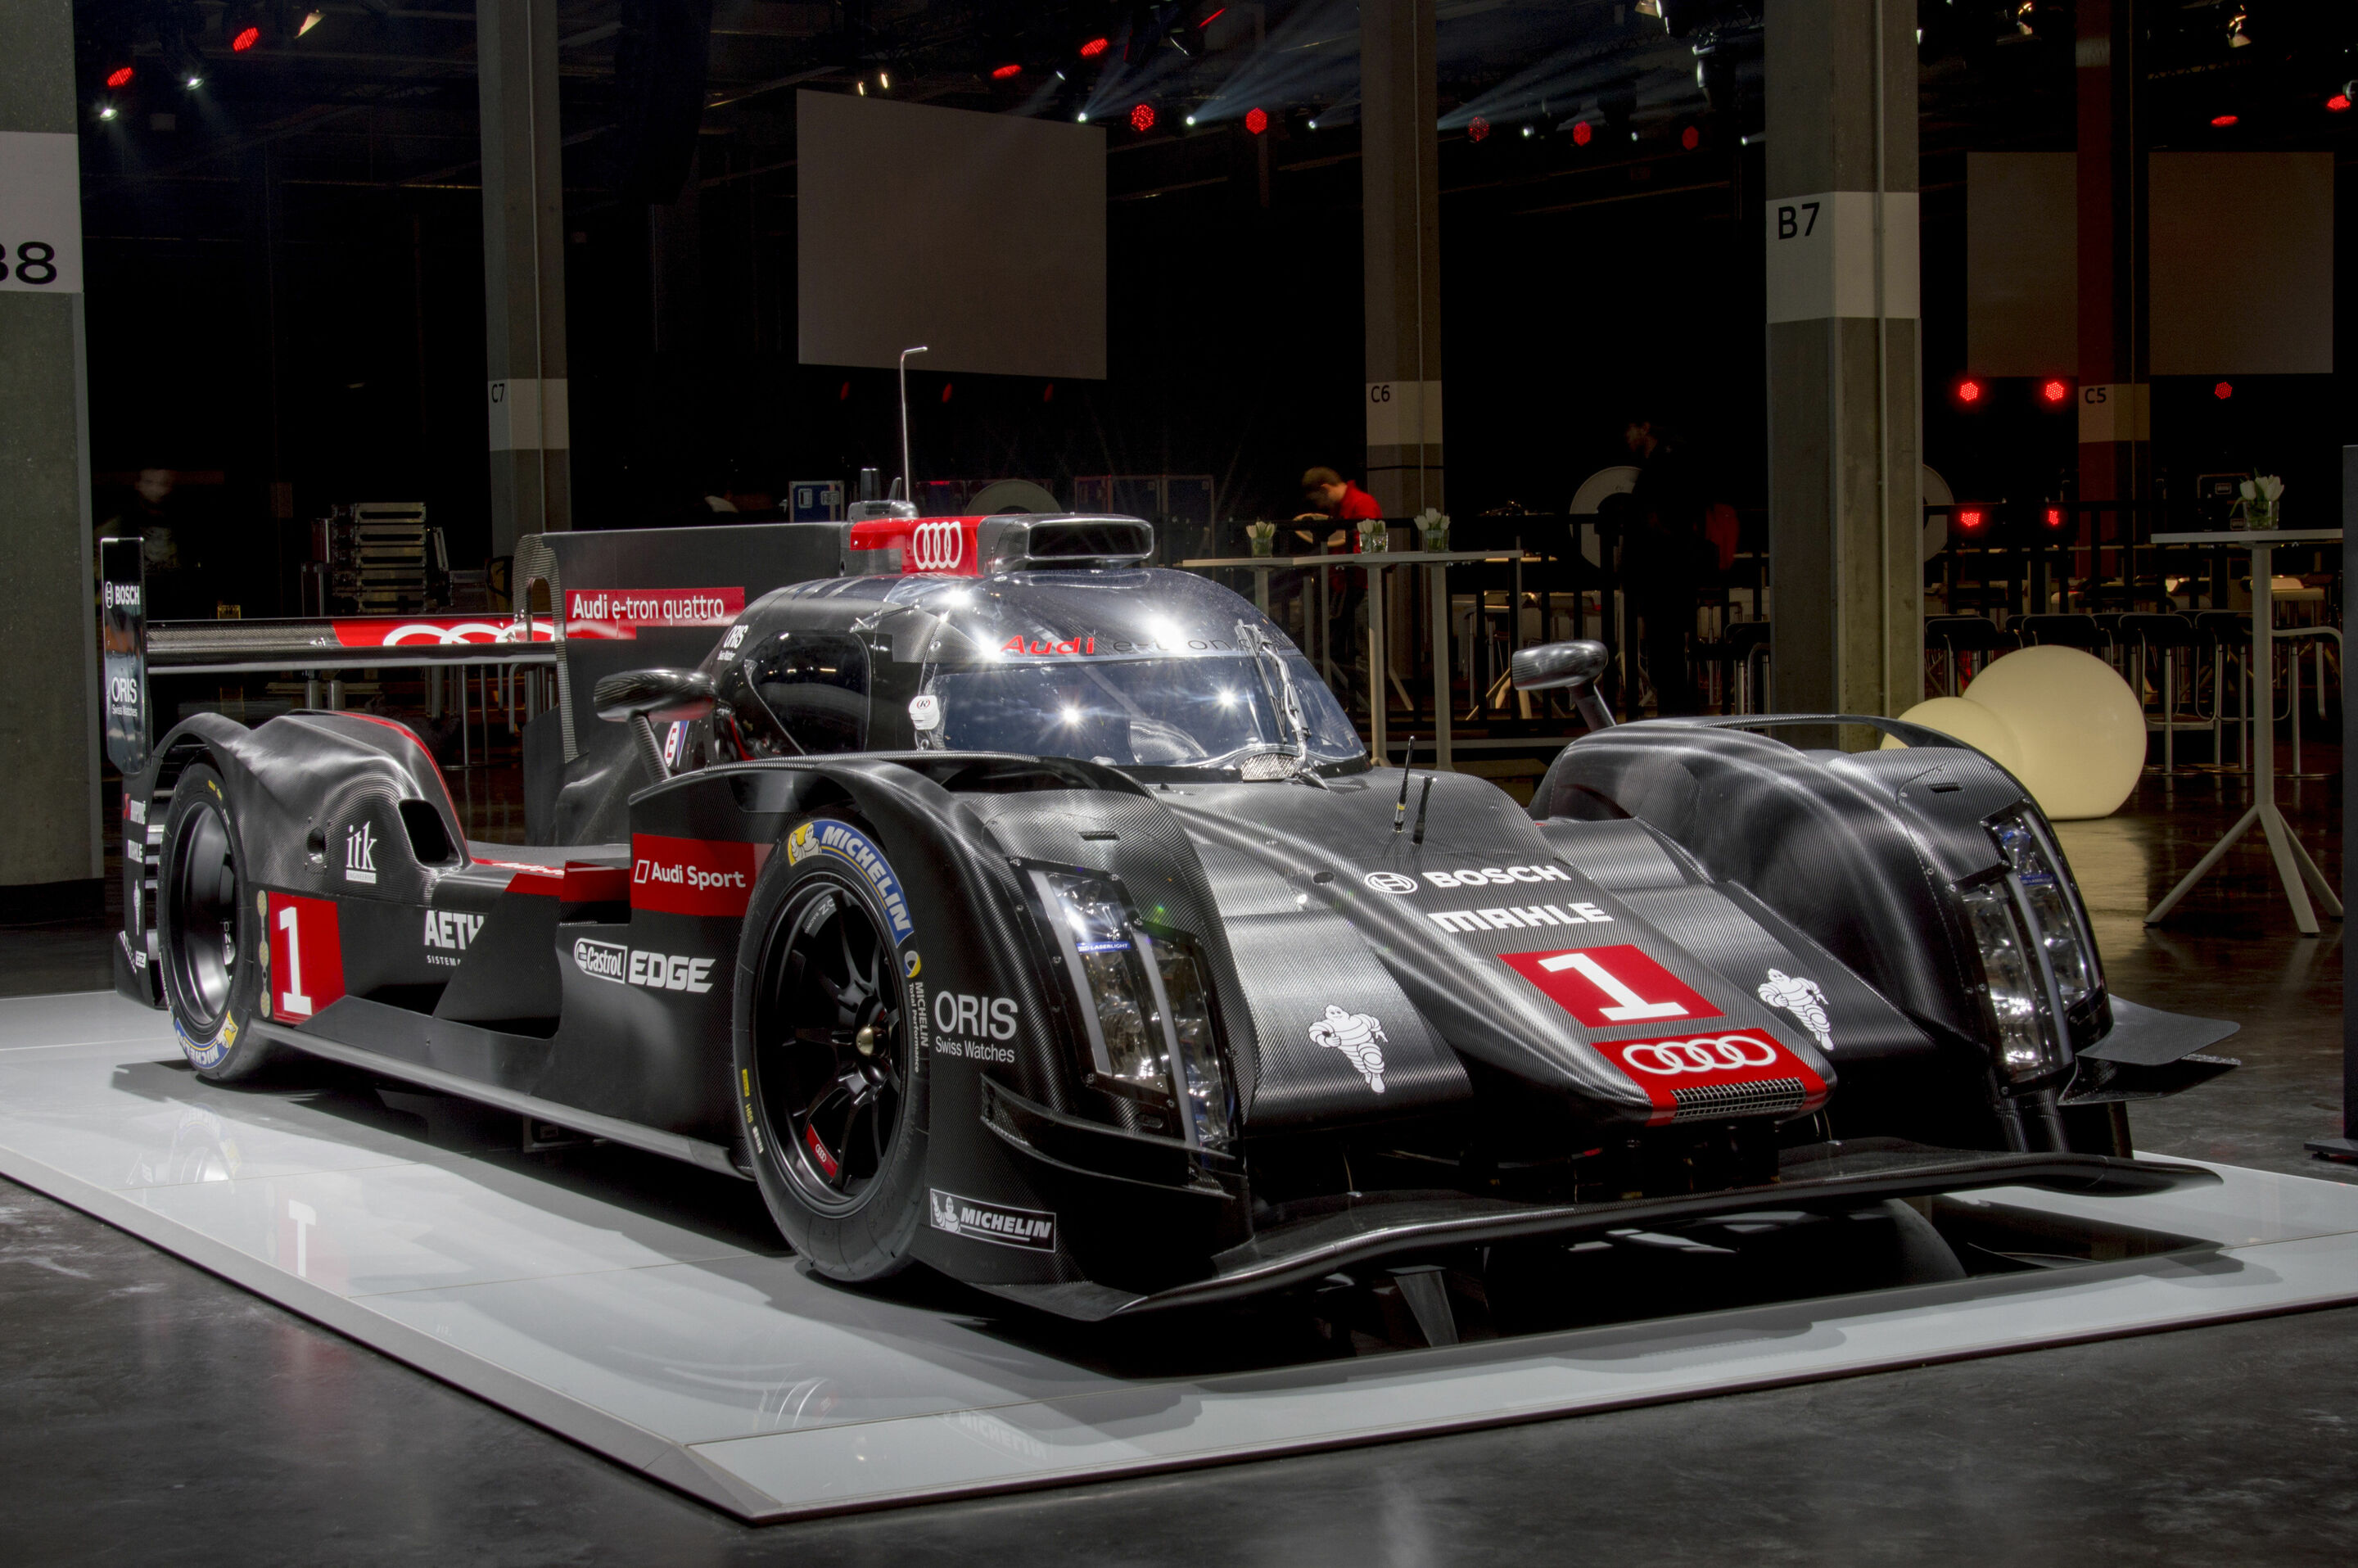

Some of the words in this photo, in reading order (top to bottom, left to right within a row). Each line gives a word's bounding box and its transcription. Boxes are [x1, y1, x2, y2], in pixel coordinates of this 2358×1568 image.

[1778, 201, 1820, 240] B7
[0, 241, 57, 285] 8
[491, 382, 505, 403] C7
[1371, 385, 1390, 403] C6
[2085, 387, 2107, 404] C5
[115, 585, 140, 605] BOSCH
[572, 594, 608, 620] Audi
[612, 596, 659, 620] e-tron
[662, 594, 725, 626] quattro
[1001, 635, 1095, 655] Audi
[111, 676, 138, 704] ORIS
[346, 820, 377, 871] itk
[651, 861, 684, 884] Audi
[687, 865, 747, 891] Sport
[820, 825, 911, 932] MICHELIN
[1421, 865, 1572, 888] BOSCH
[1427, 902, 1614, 933] MAHLE
[279, 906, 313, 1016] 1
[586, 946, 622, 977] Castrol
[629, 950, 716, 993] EDGE
[908, 983, 917, 1007] Total
[1538, 953, 1690, 1021] 1
[915, 982, 929, 1048] MICHELIN
[934, 990, 1019, 1041] ORIS
[911, 1009, 919, 1073] Performance
[935, 1035, 962, 1057] Swiss
[964, 1039, 1015, 1064] Watches
[960, 1207, 1052, 1239] MICHELIN
